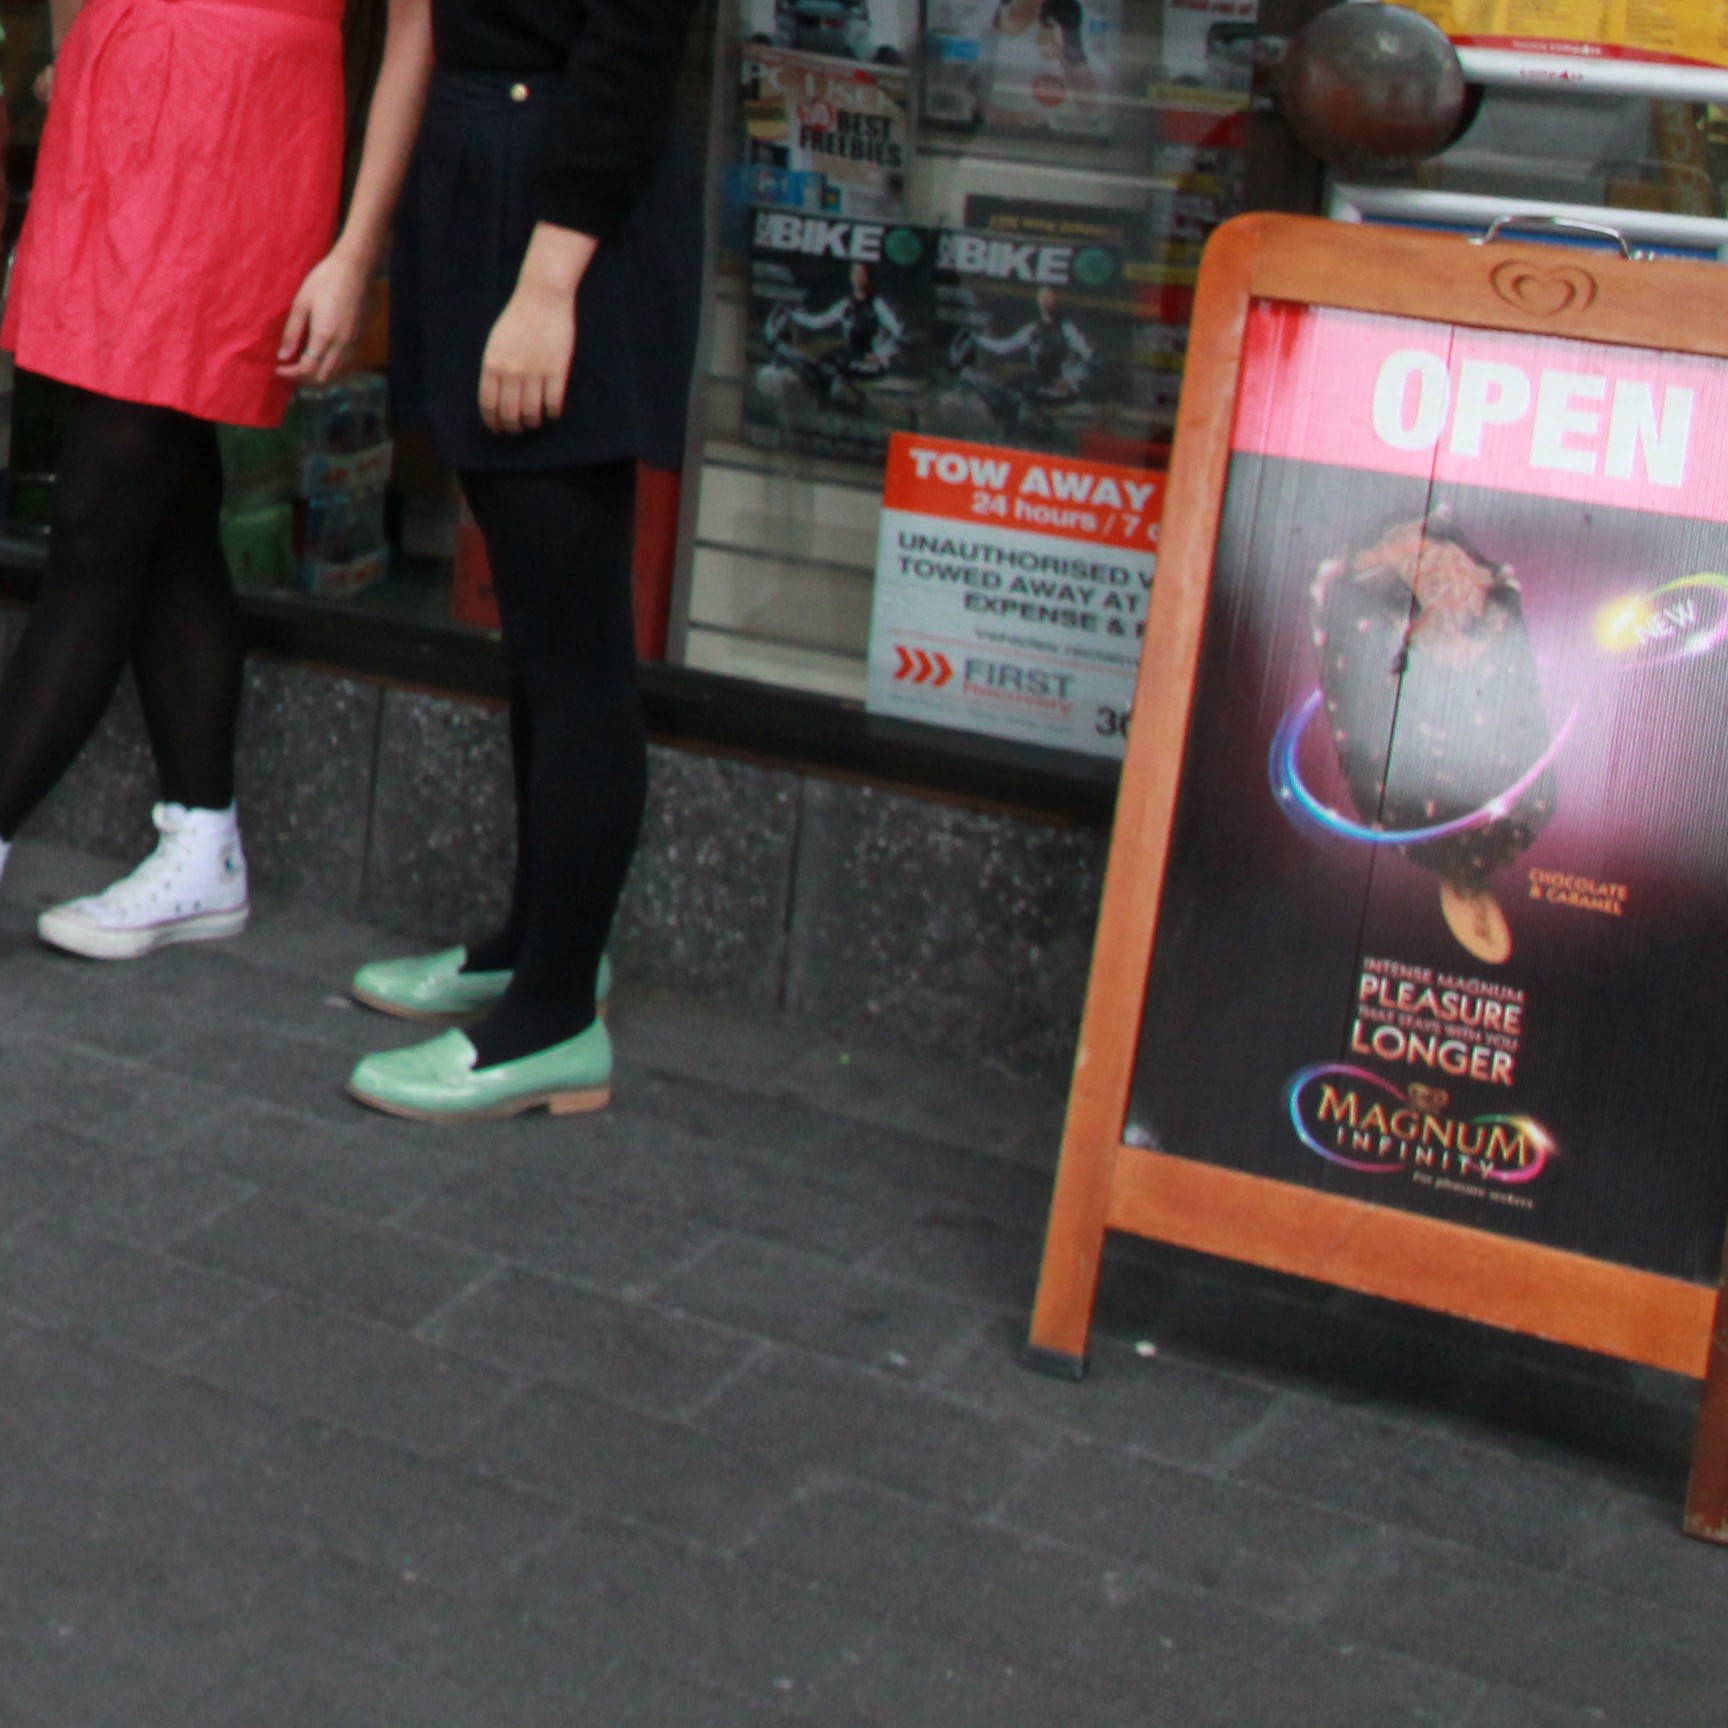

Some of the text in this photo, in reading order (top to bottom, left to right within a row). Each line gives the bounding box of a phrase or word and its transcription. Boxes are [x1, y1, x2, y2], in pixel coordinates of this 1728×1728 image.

[838, 108, 894, 134] BEST
[769, 212, 886, 264] BIKE
[954, 235, 1076, 286] BIKE
[1371, 347, 1695, 490] OPEN
[907, 446, 1157, 512] TOW AWAY
[970, 489, 1009, 518] 24
[1013, 496, 1100, 533] hours
[1122, 512, 1142, 538] 7
[896, 530, 1130, 586] UNAUTHORISED
[897, 555, 1142, 614] TOWED AWAY AT
[963, 592, 1099, 633] EXPENSE
[1105, 617, 1126, 637] &
[1634, 595, 1700, 646] NEW
[964, 657, 1076, 700] FIRST
[1528, 868, 1631, 902] CHOCOLATE
[1528, 886, 1625, 917] & CARAMEL
[1358, 973, 1526, 1036] PLEASURE
[1362, 956, 1527, 1003] INTENSE MAGNUM
[1350, 1018, 1518, 1088] LONGER
[1357, 1003, 1521, 1052] THAT STAYS WITH YOU
[1316, 1082, 1536, 1169] MAGNUM
[1336, 1124, 1496, 1181] INFINITY
[1434, 1173, 1488, 1200] pleasure
[1488, 1189, 1536, 1211] seekers
